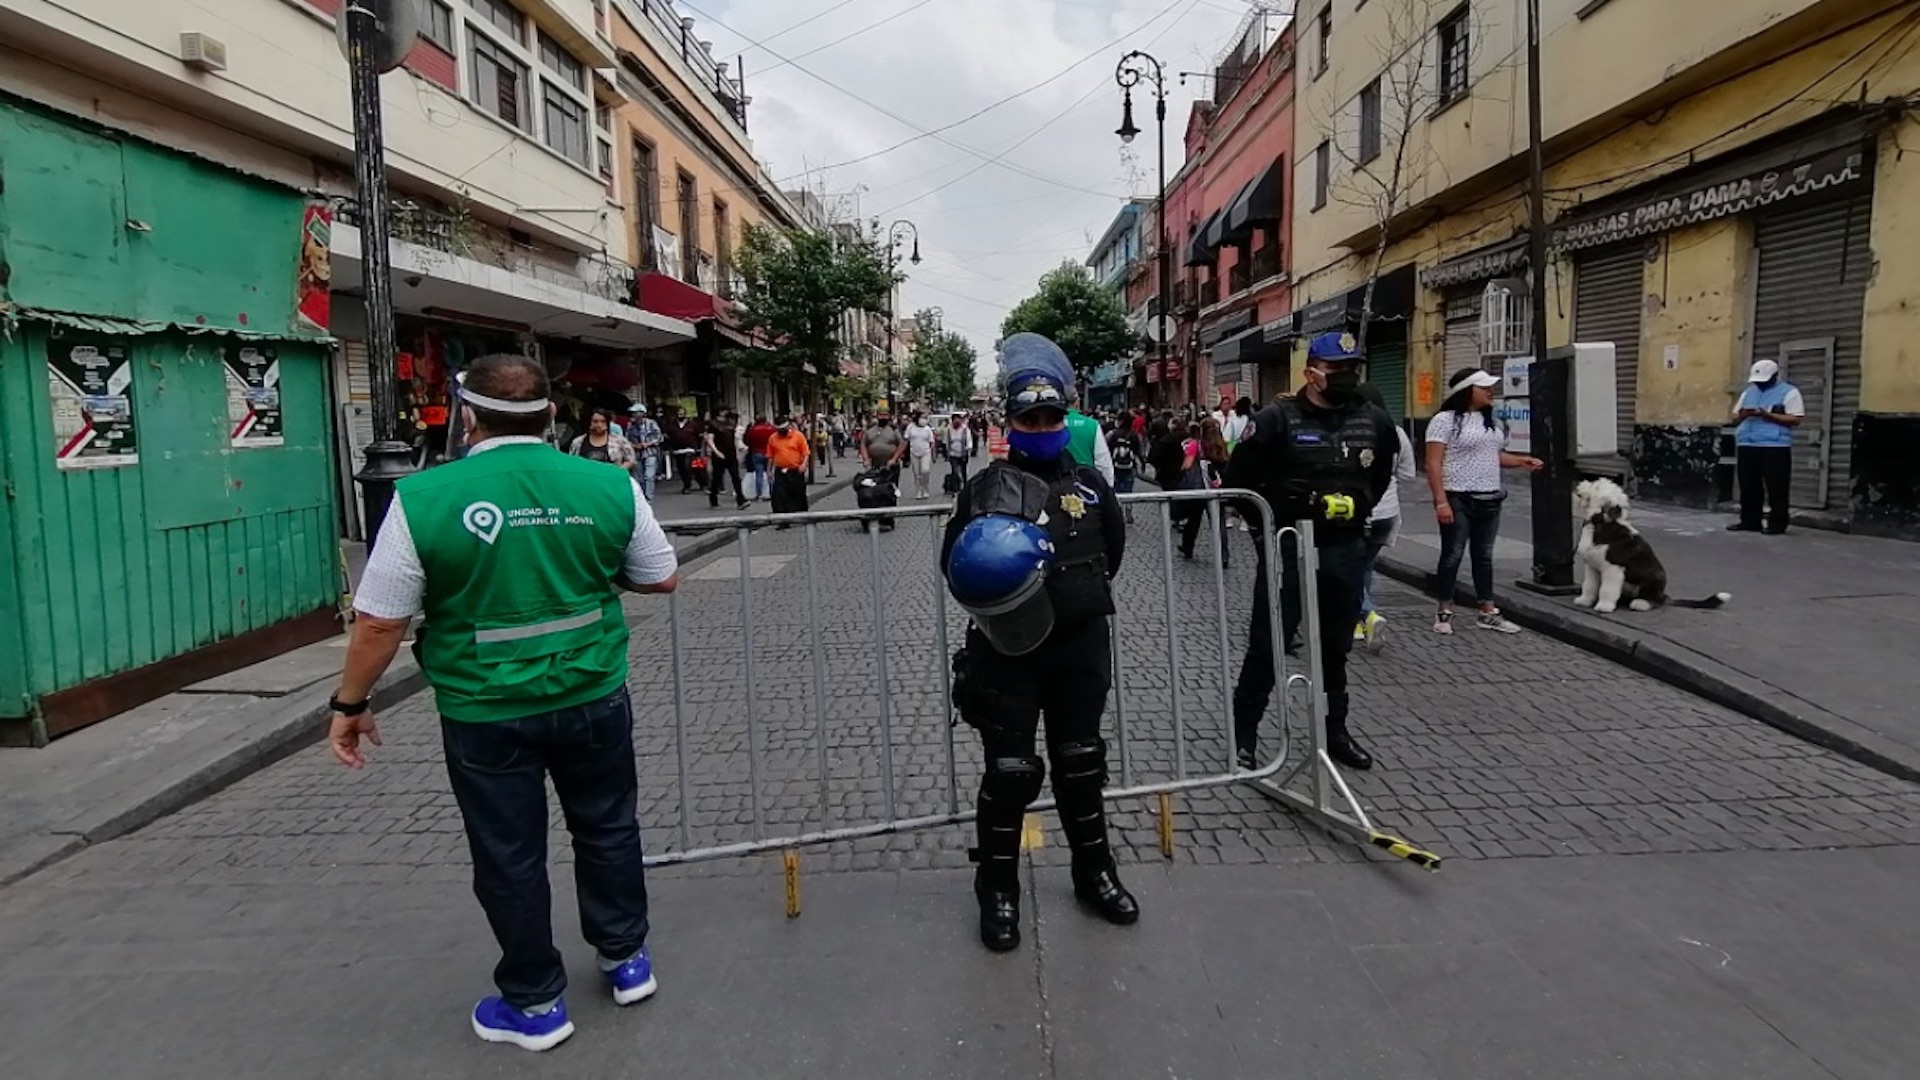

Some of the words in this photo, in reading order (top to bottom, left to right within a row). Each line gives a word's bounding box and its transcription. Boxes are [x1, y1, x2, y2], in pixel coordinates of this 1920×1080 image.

[1566, 211, 1629, 240] BOLSAS
[1634, 197, 1682, 225] PARA
[1689, 178, 1751, 211] DAMA
[506, 507, 543, 517] UNIDAD
[547, 507, 560, 515] DE
[508, 516, 560, 527] VIGILANCIA
[564, 515, 595, 525] MÓVIL
